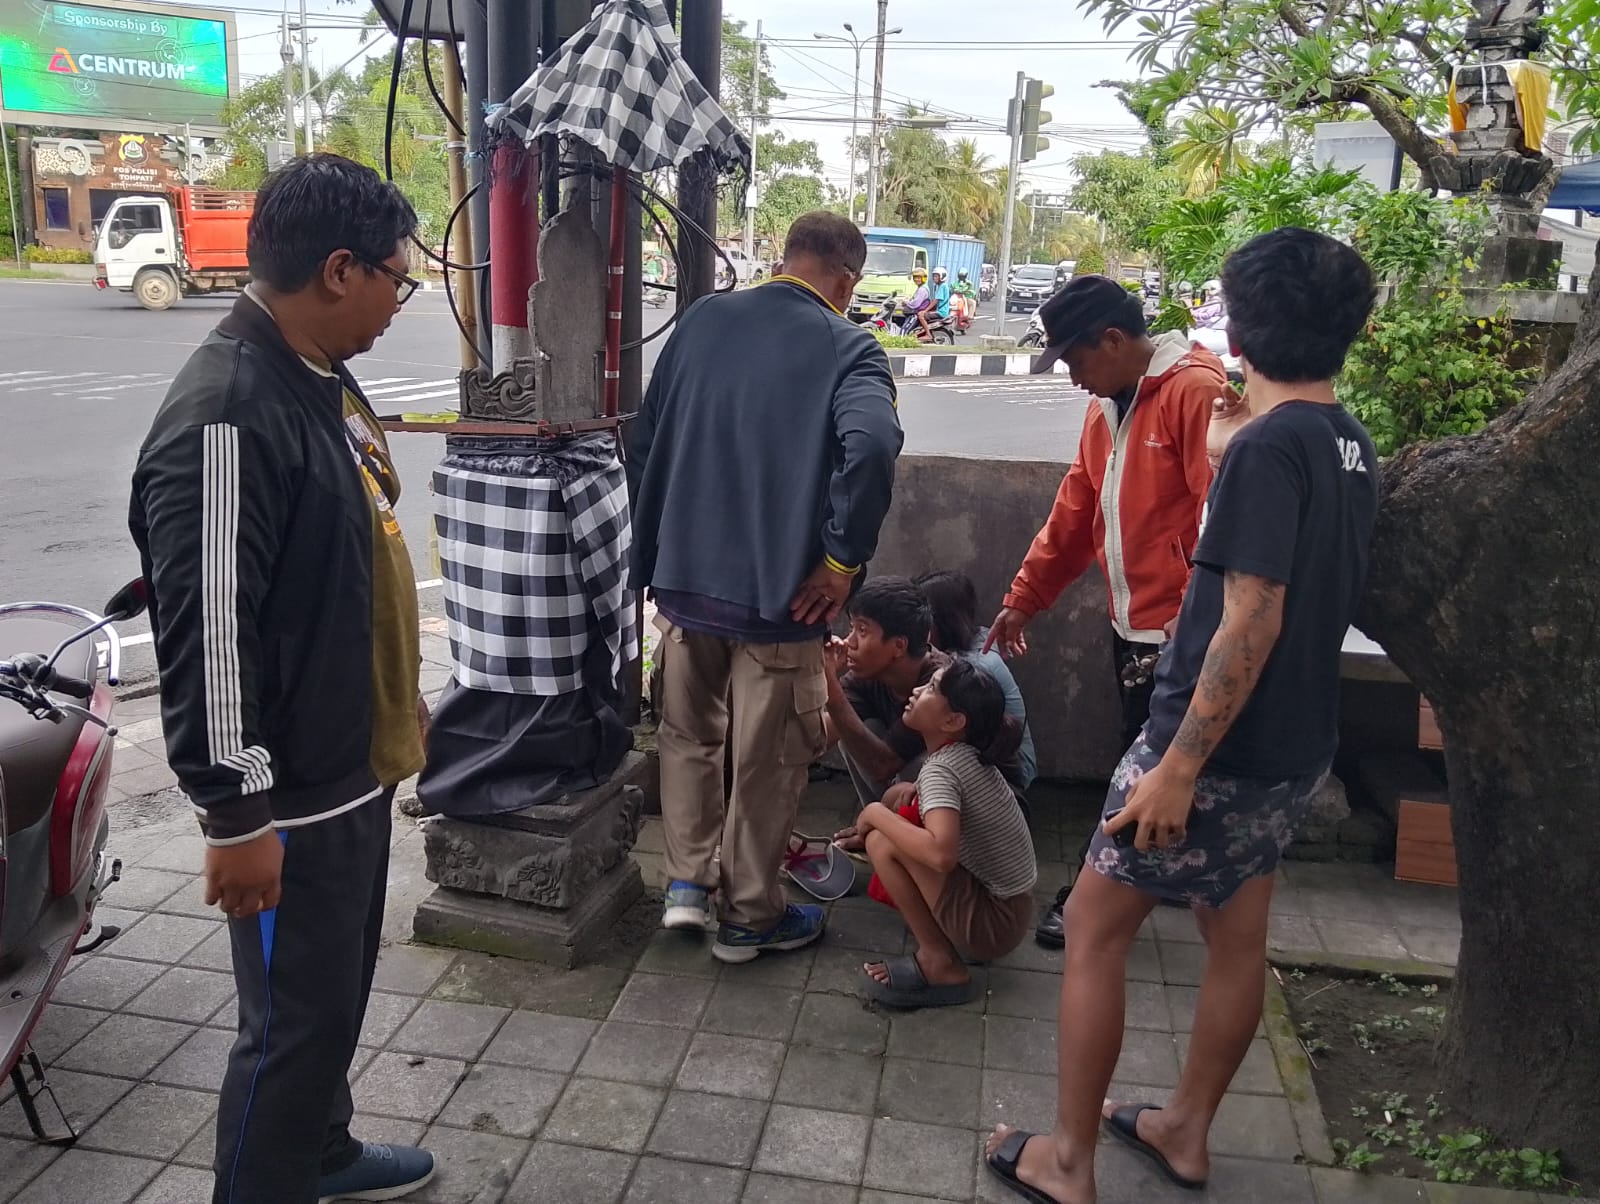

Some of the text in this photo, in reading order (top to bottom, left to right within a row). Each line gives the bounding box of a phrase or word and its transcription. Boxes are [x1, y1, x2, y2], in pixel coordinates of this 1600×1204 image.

[64, 10, 168, 35] Sponsorship By
[78, 54, 185, 80] CENTRUM
